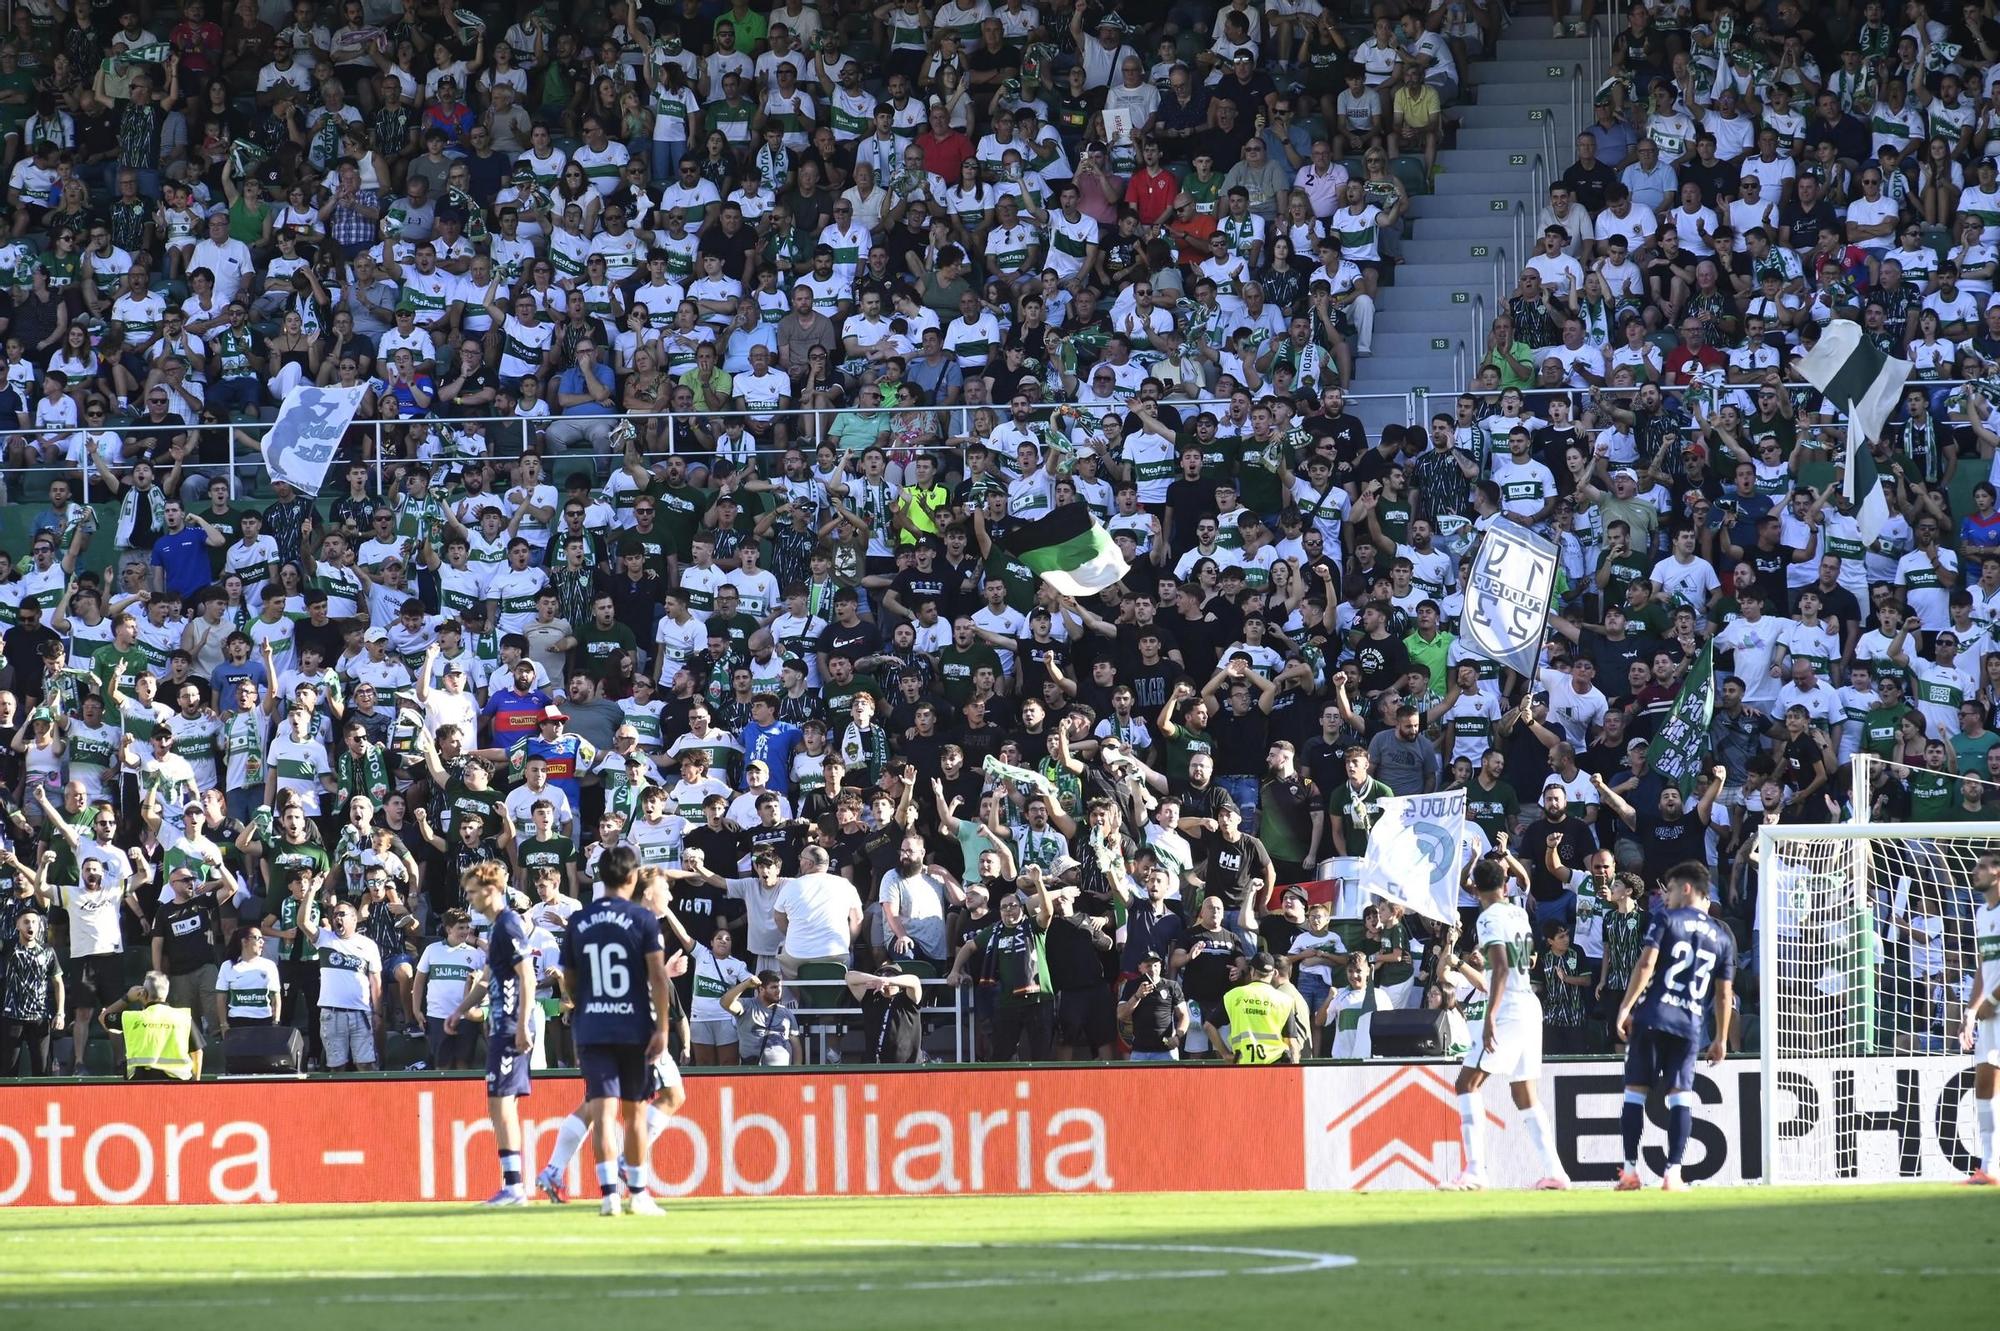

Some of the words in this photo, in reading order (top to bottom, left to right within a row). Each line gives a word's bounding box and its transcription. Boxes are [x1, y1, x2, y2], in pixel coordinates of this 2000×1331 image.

[1549, 67, 1561, 76] 24
[1530, 111, 1543, 120] 23
[1512, 155, 1524, 164] 22
[1305, 174, 1315, 187] 2
[1494, 201, 1504, 209] 21
[1473, 247, 1486, 256] 20
[1455, 294, 1465, 302] 19
[1435, 340, 1445, 348] 18
[1416, 388, 1425, 396] 17
[77, 741, 110, 756] ELCHE
[1219, 851, 1241, 868] HH
[174, 922, 185, 931] TM
[583, 943, 630, 998] 16
[1664, 940, 1717, 1000] 23
[585, 1002, 634, 1014] ABANCA
[1246, 1044, 1266, 1063] 70
